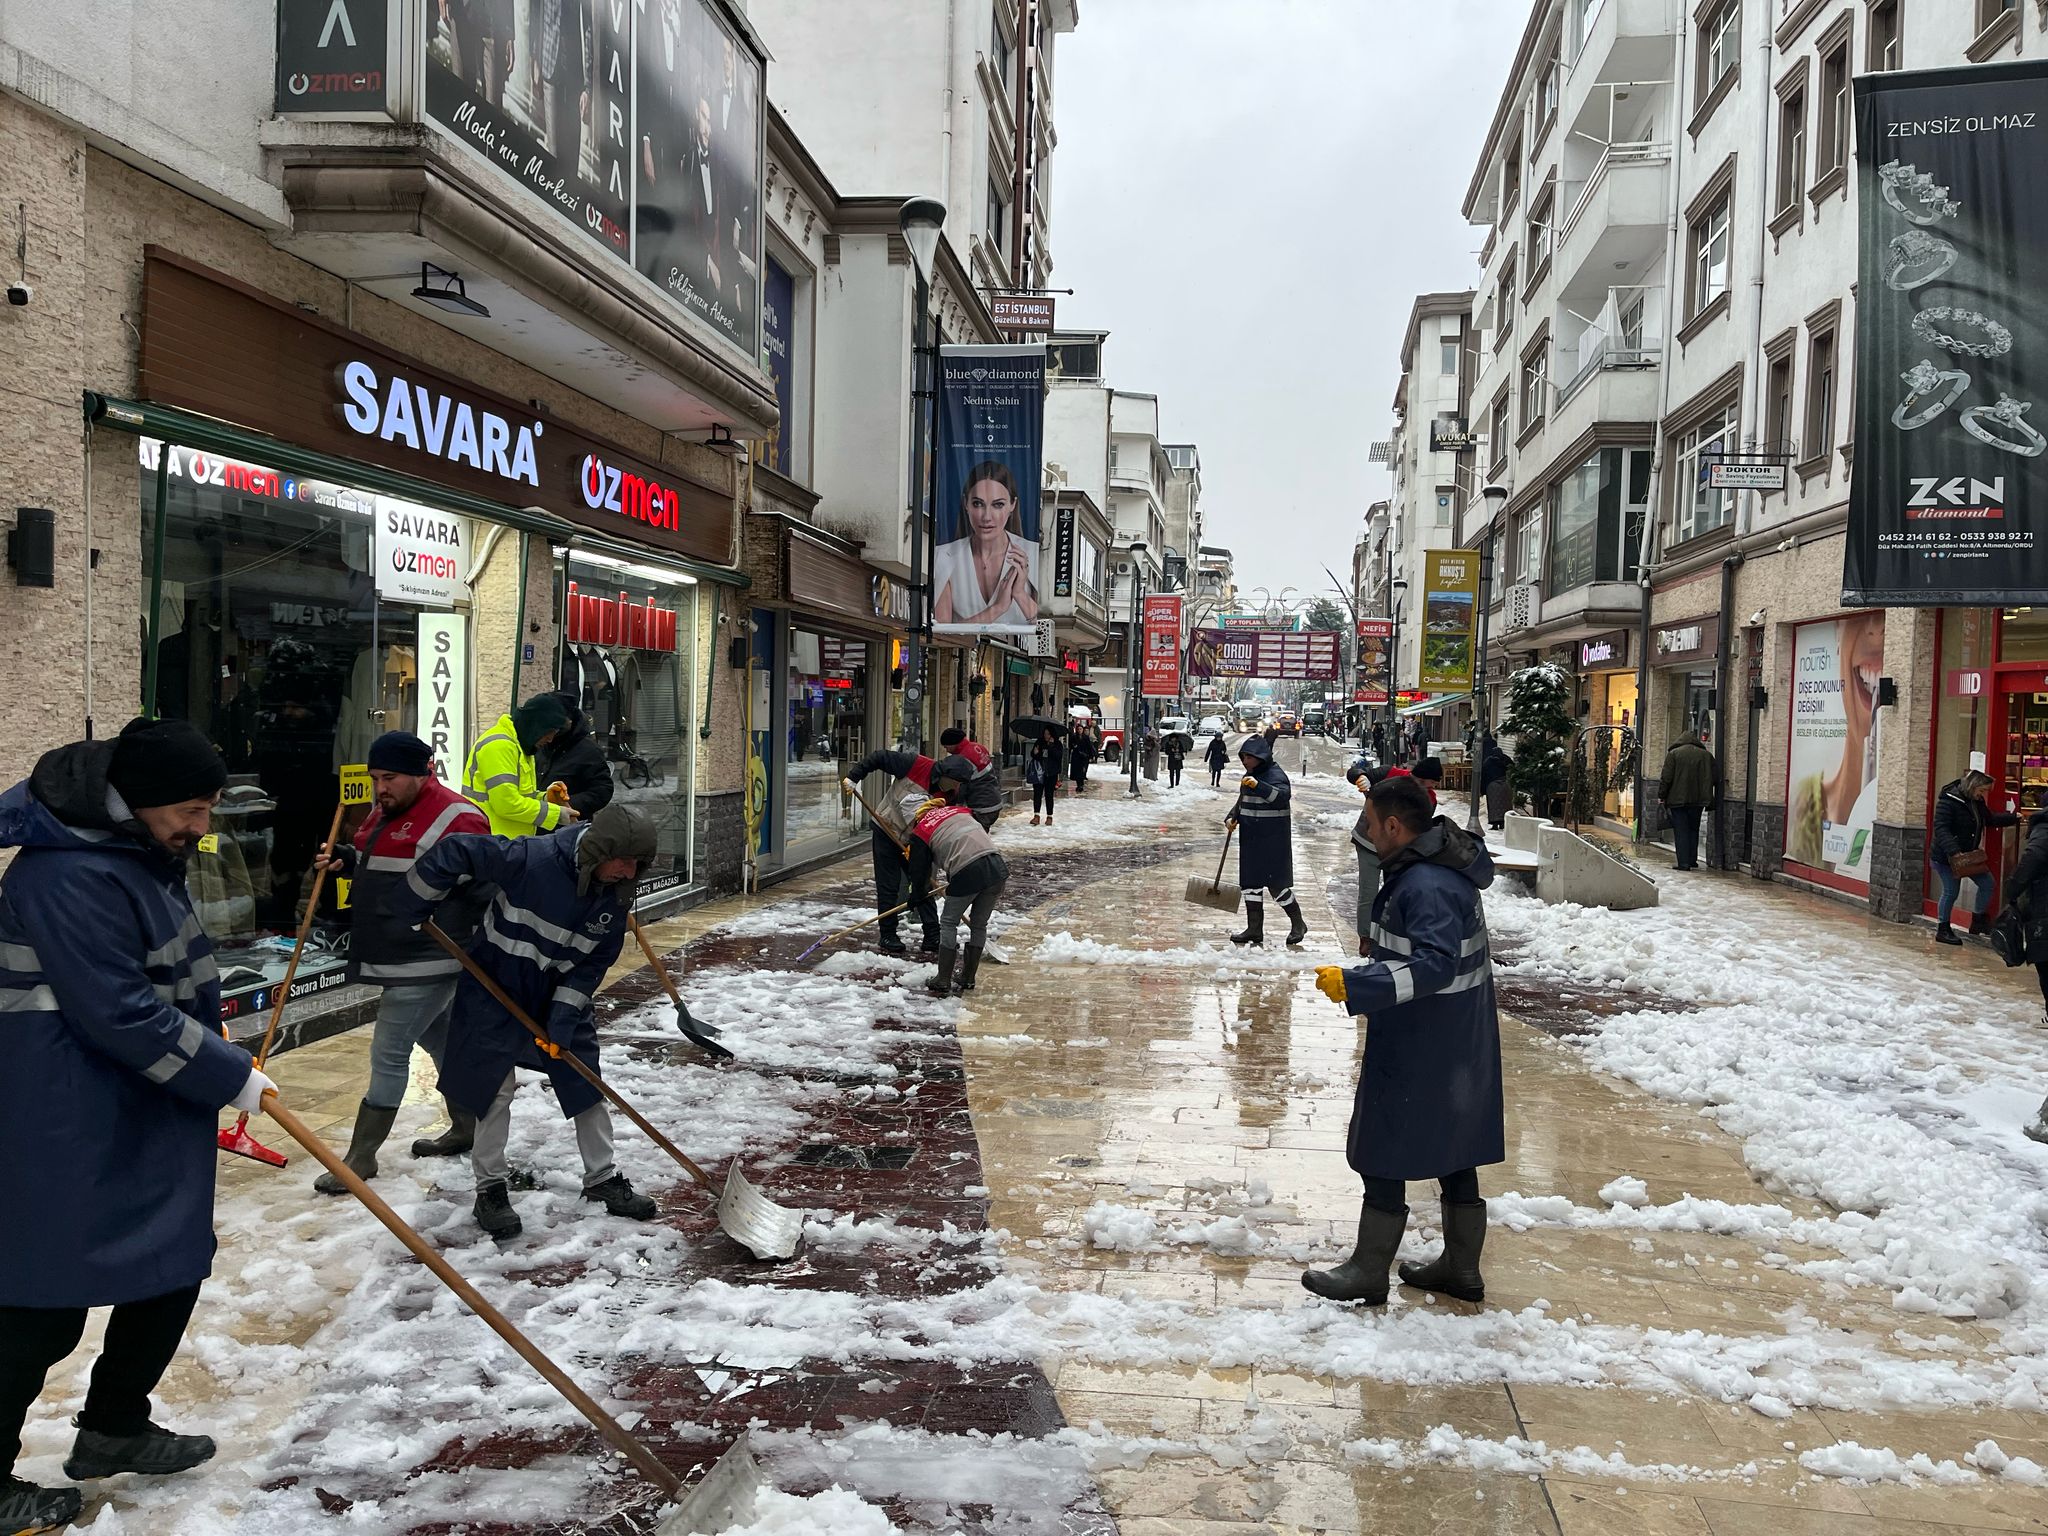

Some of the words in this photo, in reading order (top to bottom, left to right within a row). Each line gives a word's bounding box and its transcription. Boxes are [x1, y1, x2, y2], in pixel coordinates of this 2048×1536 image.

[1965, 112, 2036, 132] OLMAZ
[522, 154, 581, 212] Merkezi
[994, 303, 1010, 314] EST
[1011, 301, 1050, 315] İSTANBUL
[994, 315, 1021, 324] Güzellik
[1022, 315, 1027, 324] &
[1028, 316, 1050, 325] Bakım
[945, 368, 971, 379] blue
[988, 368, 1040, 379] diamond
[963, 396, 992, 405] Nedim
[994, 396, 1020, 406] Şahin
[343, 361, 539, 487] SAVARA
[1435, 432, 1471, 442] AVUKAT
[1907, 476, 2004, 506] ZEN
[314, 491, 336, 507] Savara
[1917, 507, 1990, 519] diamond
[388, 511, 460, 547] SAVARA
[1878, 533, 1904, 541] 0452
[1906, 533, 1922, 541] 214
[1960, 532, 1985, 540] 0533
[1988, 532, 2006, 540] 938
[2008, 532, 2021, 540] 92
[2023, 532, 2034, 540] 71
[1060, 521, 1069, 579] INTERNET
[567, 581, 676, 653] İNDİRİM
[1152, 614, 1178, 622] FIRSAT
[1363, 625, 1387, 633] NEFİS
[1224, 644, 1252, 659] ORDU
[1588, 640, 1611, 663] vodafone
[1146, 660, 1175, 671] 67.500
[1800, 650, 1831, 671] nourish
[1813, 679, 1846, 694] DOKUNUR
[432, 631, 453, 781] SAVARA
[652, 876, 679, 890] MAĞAZASI
[290, 983, 318, 997] Savara
[319, 974, 345, 989] Özmen
